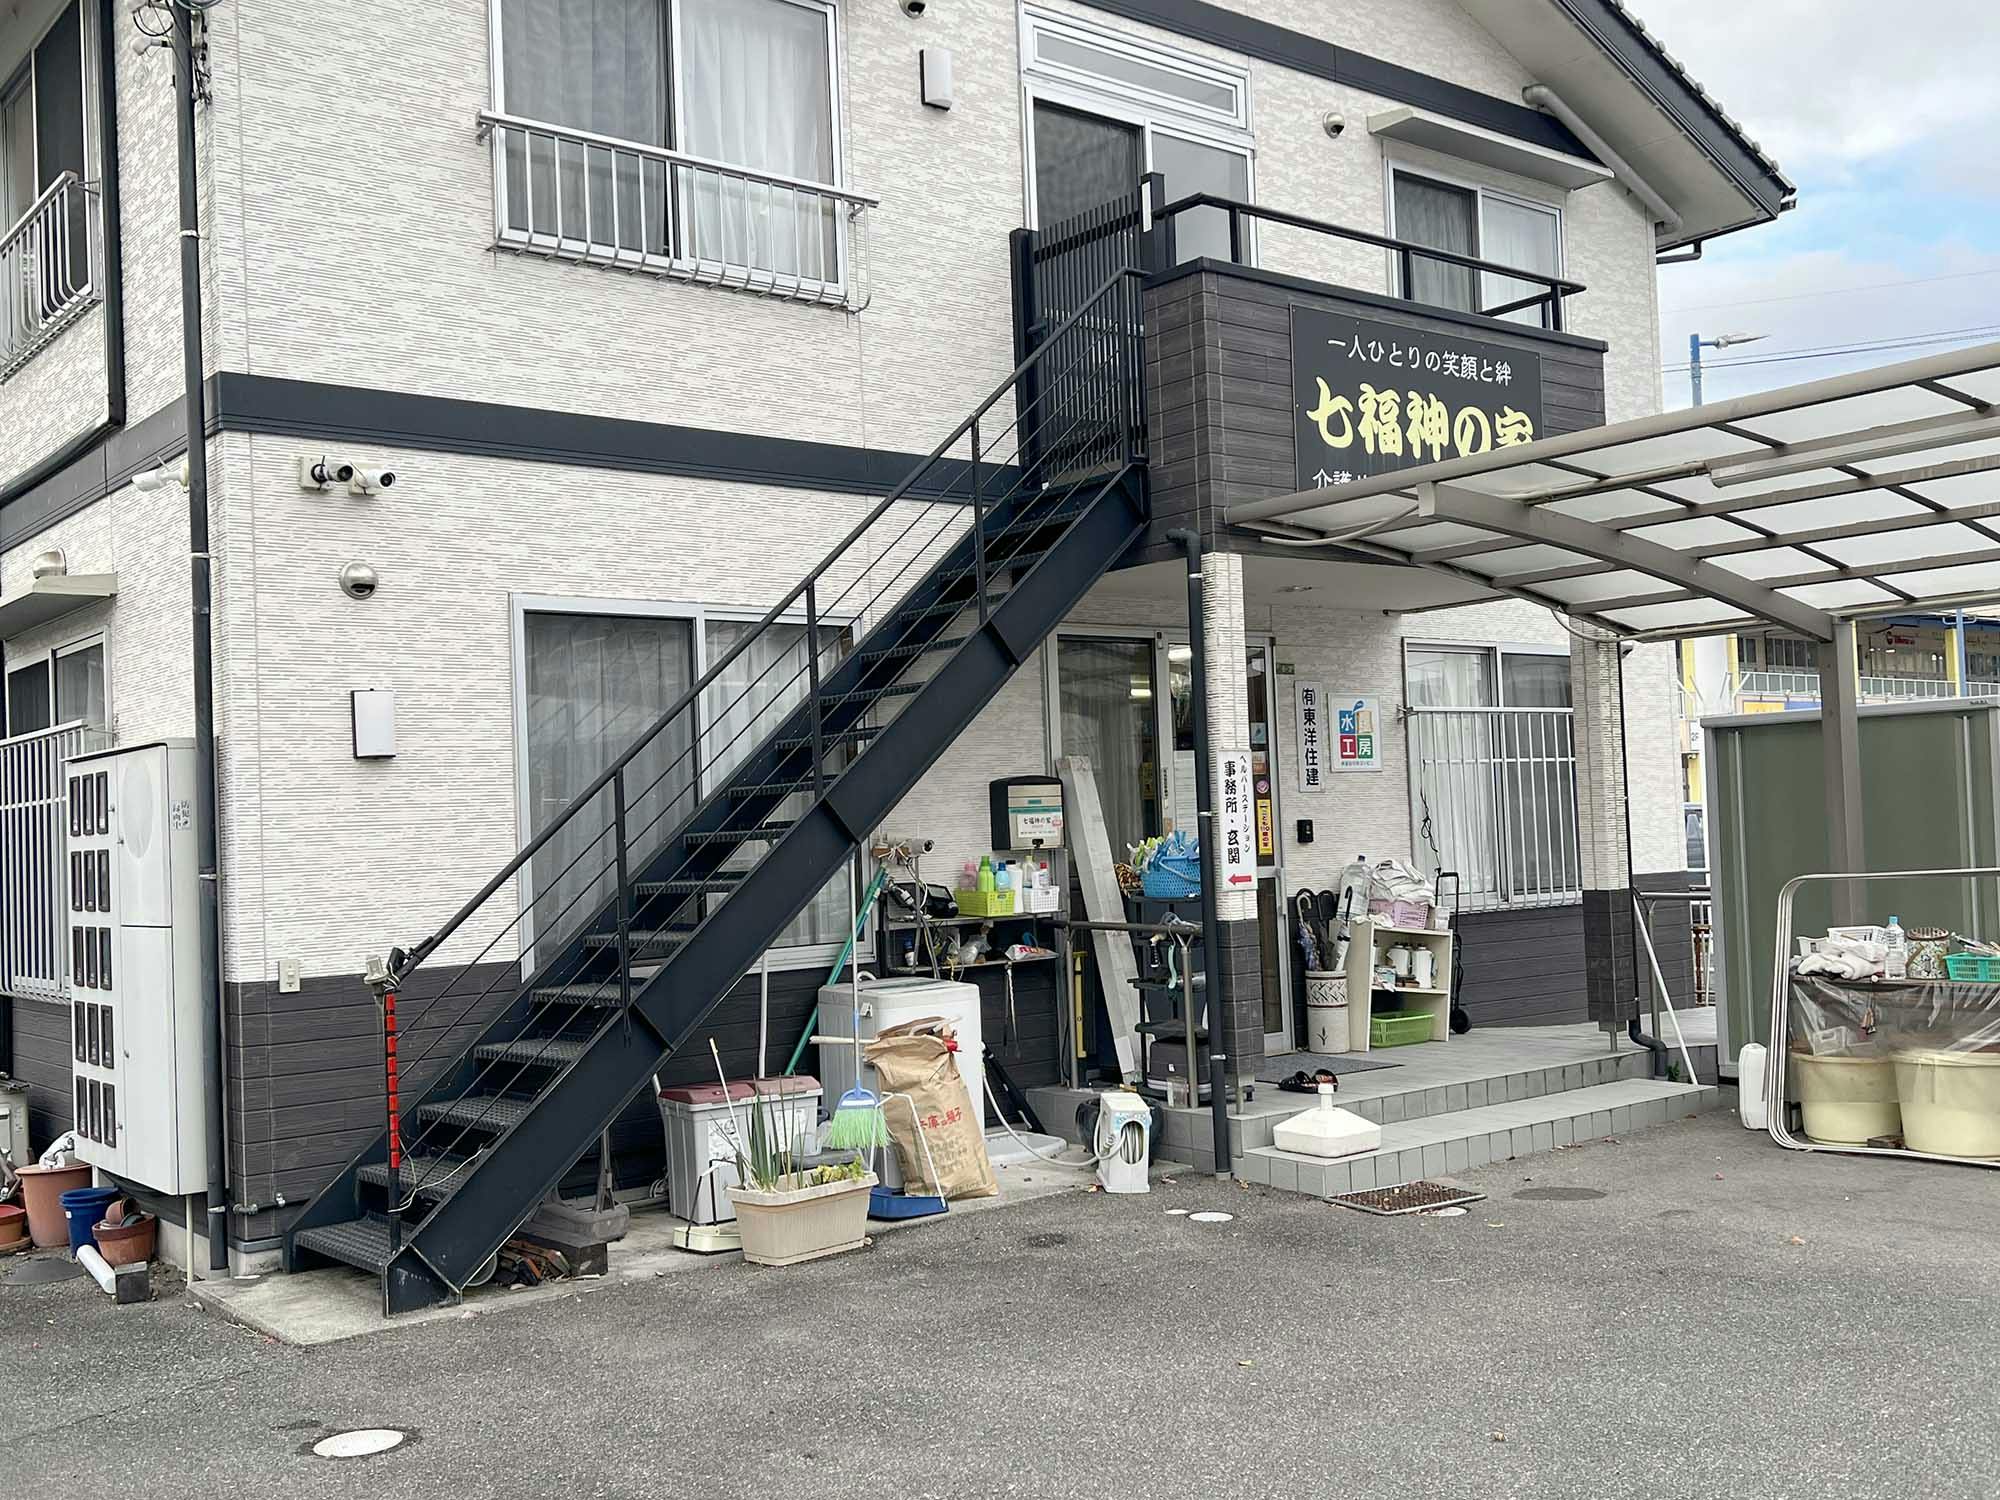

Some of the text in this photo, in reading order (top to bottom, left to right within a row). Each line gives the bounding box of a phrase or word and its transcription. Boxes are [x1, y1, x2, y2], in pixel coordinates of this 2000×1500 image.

[1327, 334, 1513, 387] 一人ひとりの笑顔と絆
[1305, 376, 1535, 463] 七福神の家
[1311, 467, 1368, 490] 介護
[1223, 760, 1241, 865] 事務所・玄関
